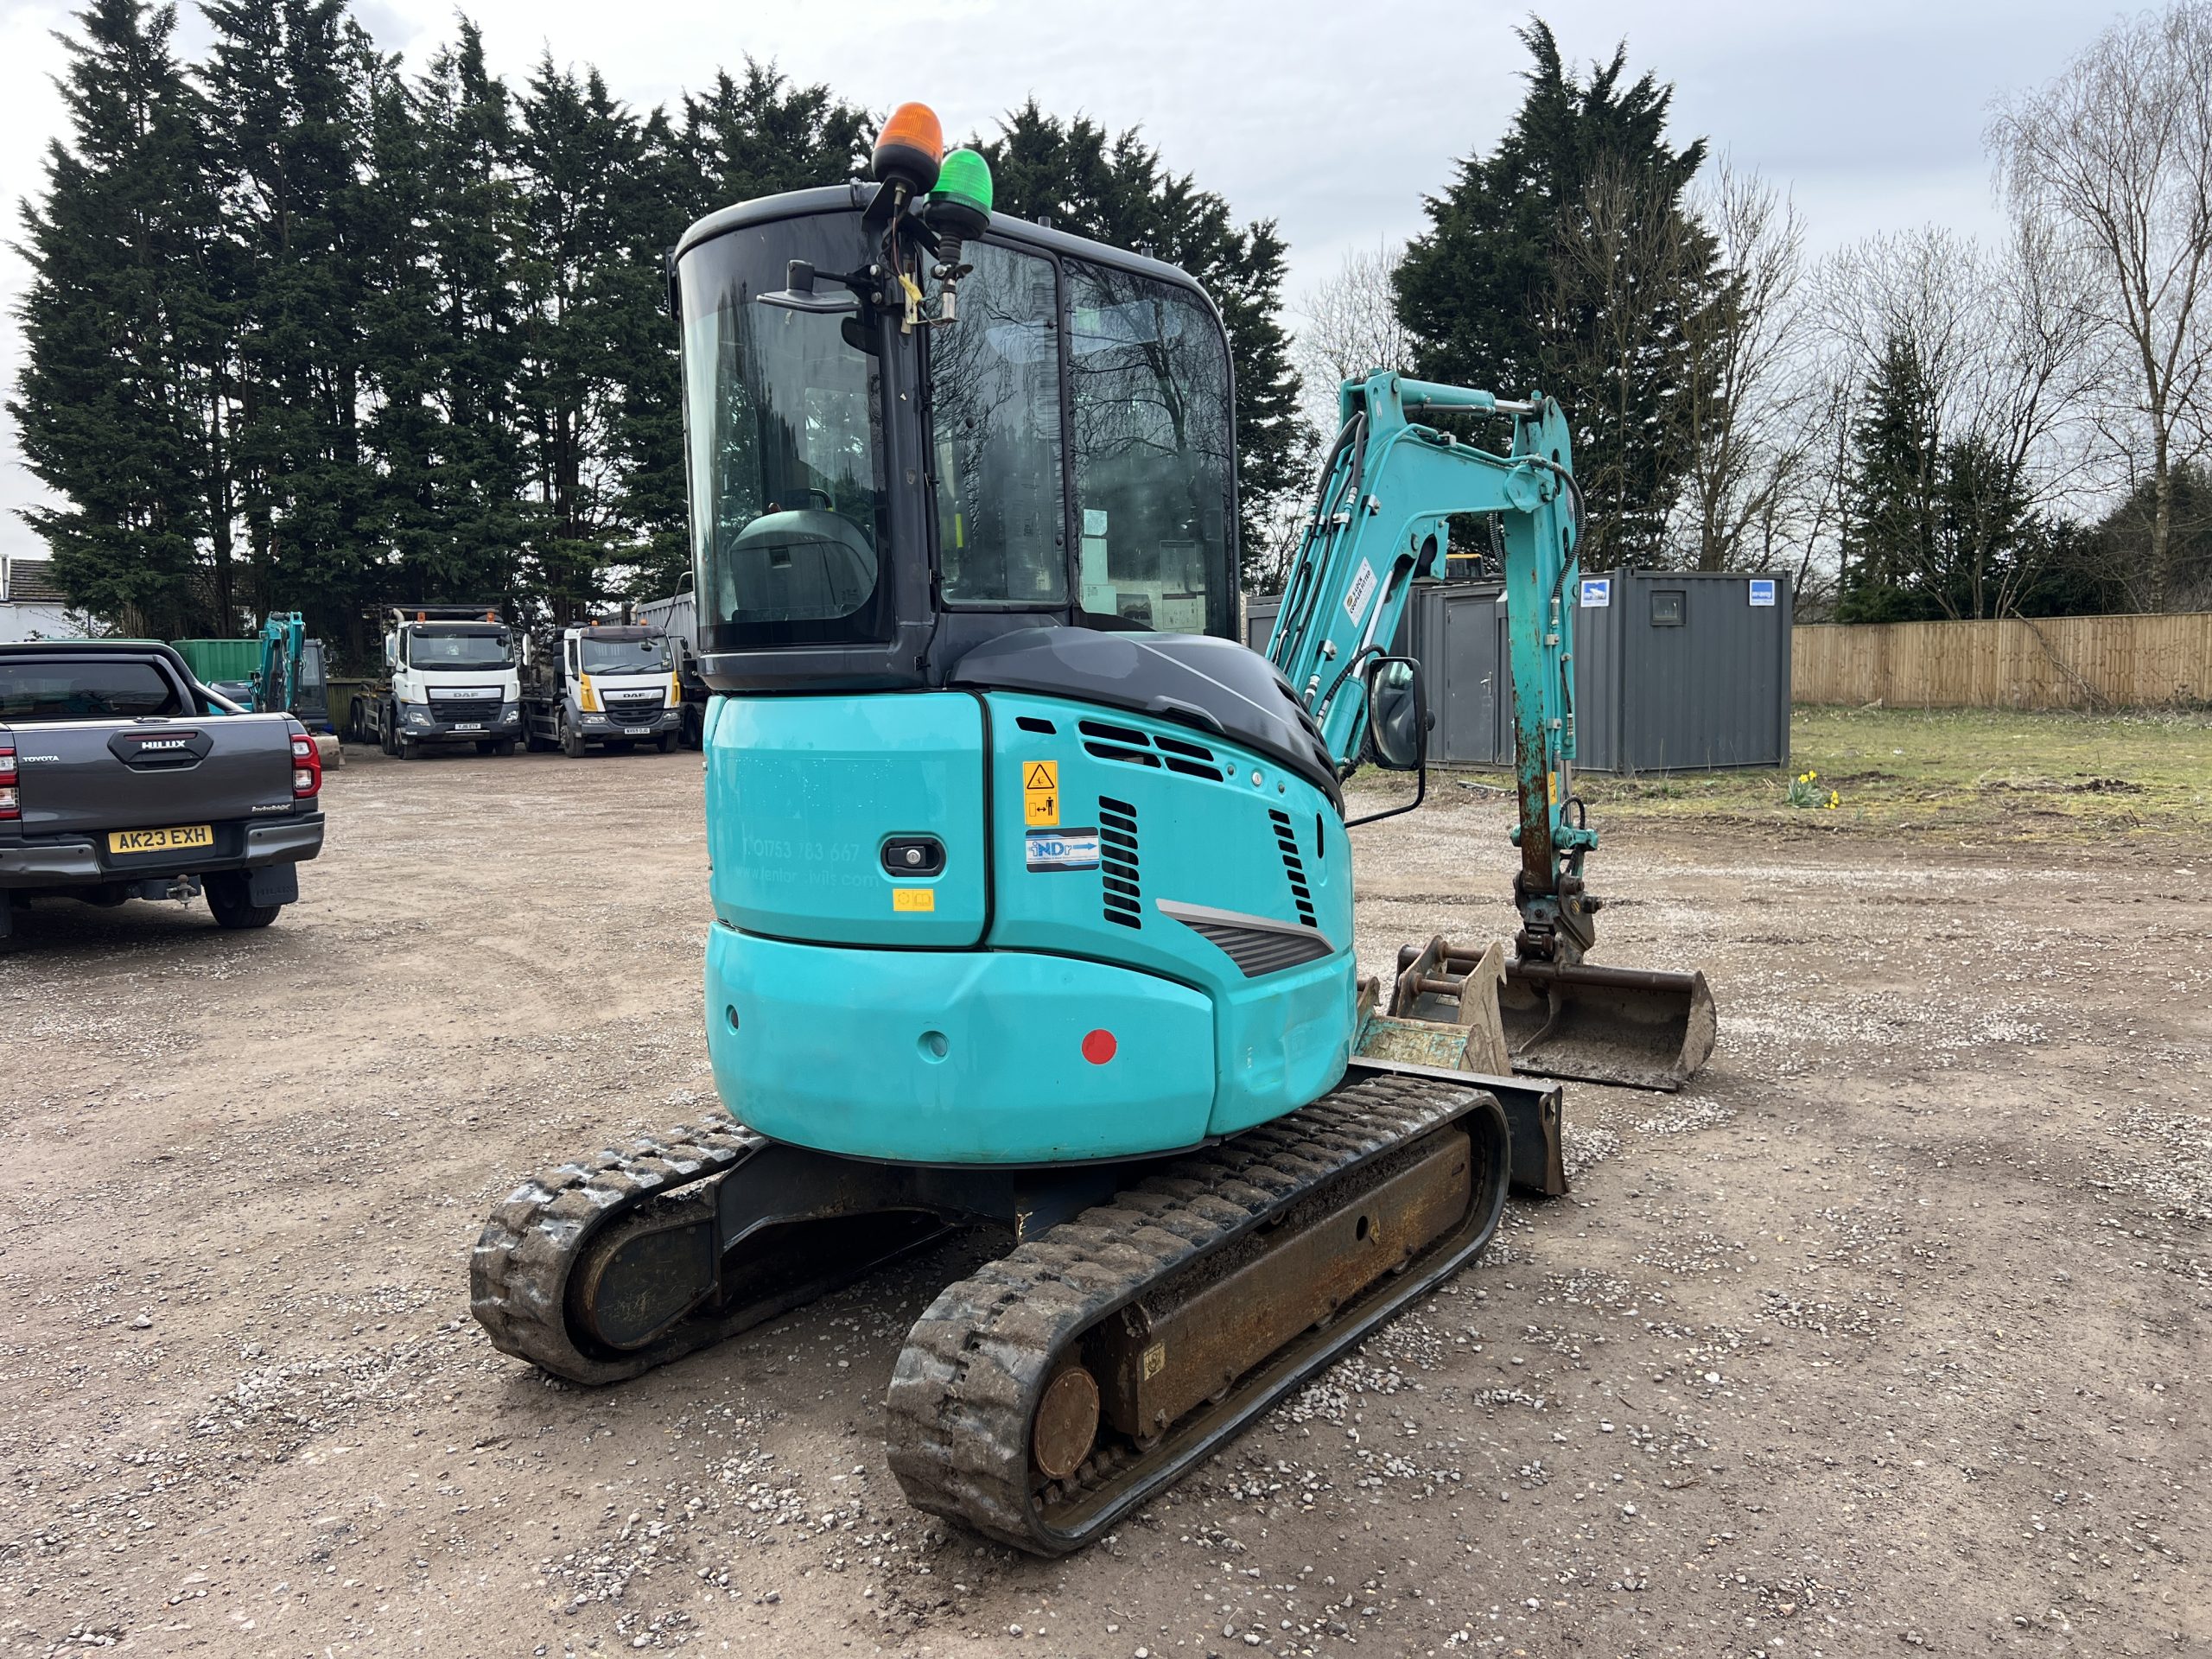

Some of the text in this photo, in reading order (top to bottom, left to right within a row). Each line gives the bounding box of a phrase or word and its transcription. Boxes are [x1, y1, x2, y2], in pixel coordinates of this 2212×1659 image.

[1350, 588, 1363, 613] COUPLER
[1361, 570, 1370, 589] FITTED
[142, 740, 186, 749] HILUX
[119, 827, 207, 849] AK23 EXH
